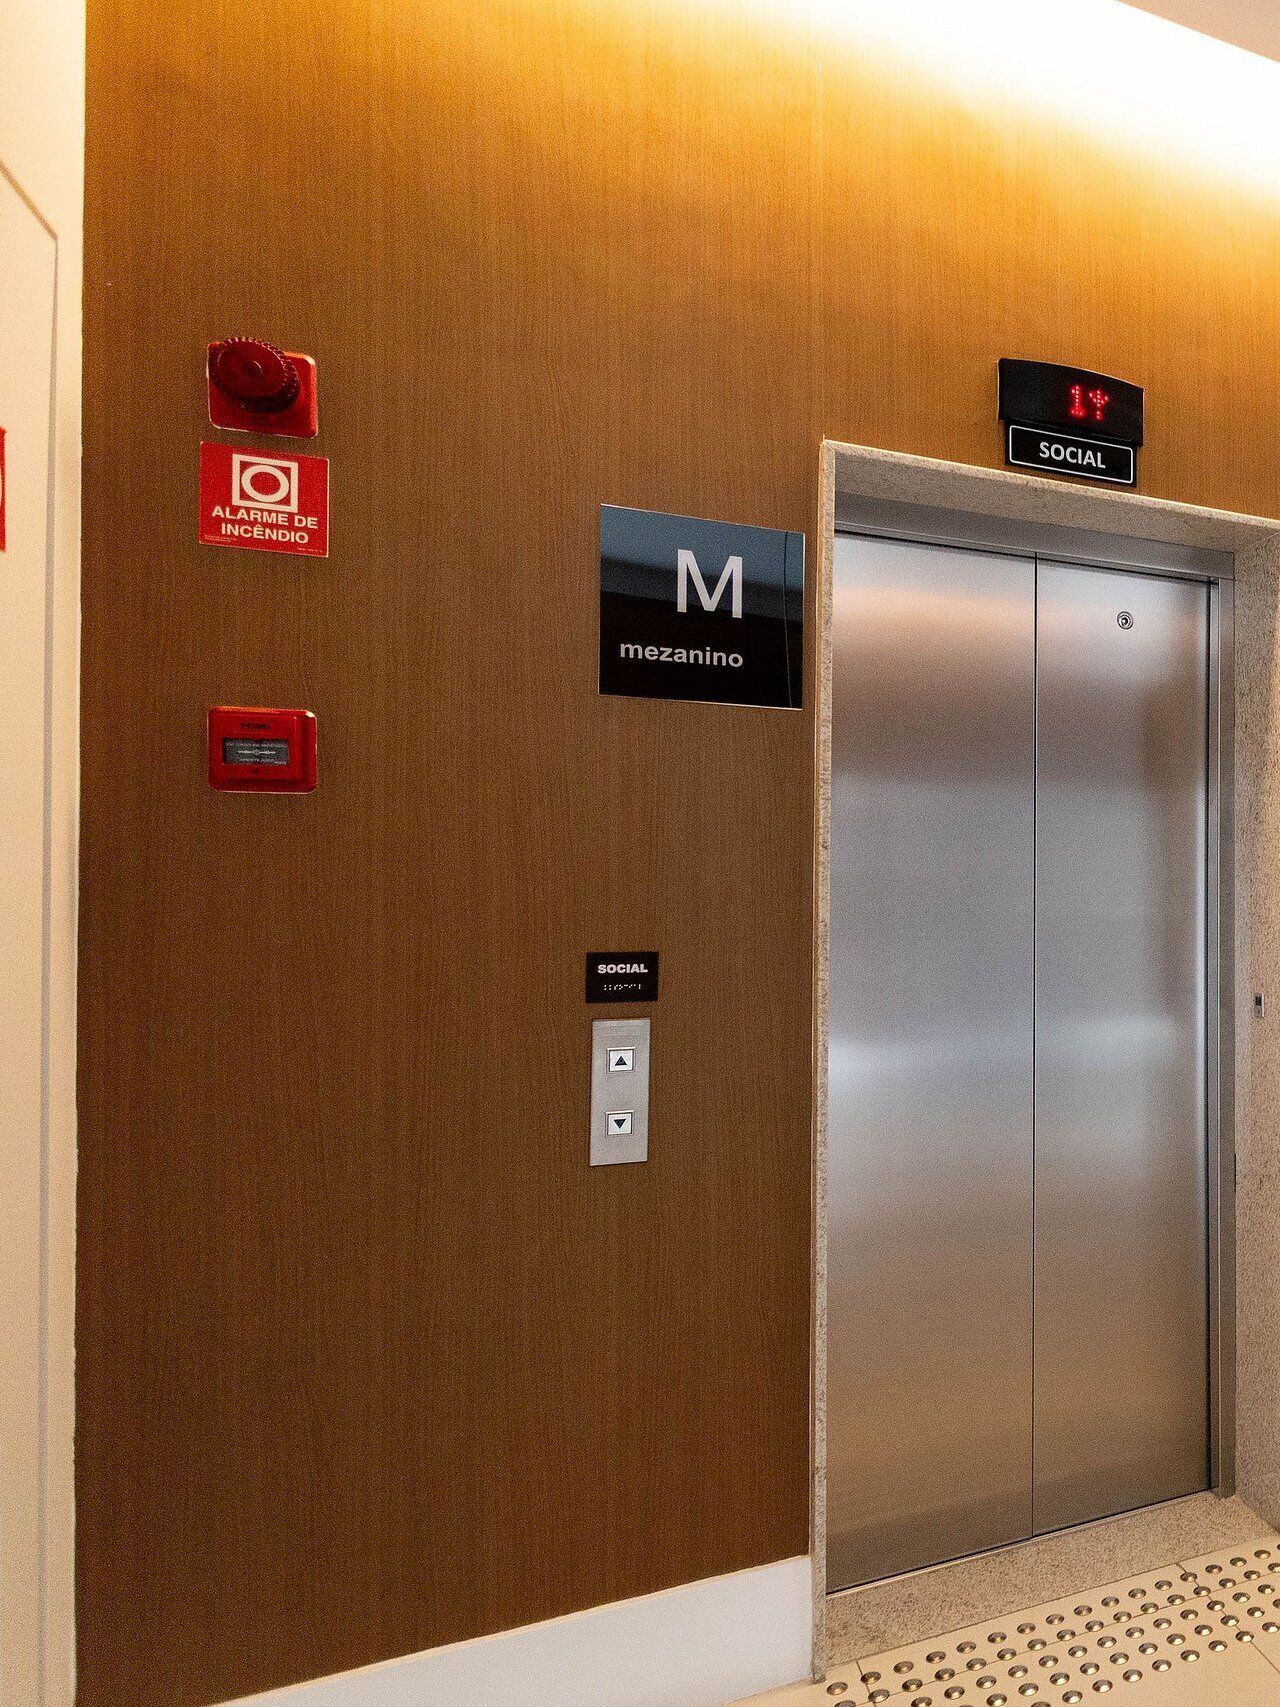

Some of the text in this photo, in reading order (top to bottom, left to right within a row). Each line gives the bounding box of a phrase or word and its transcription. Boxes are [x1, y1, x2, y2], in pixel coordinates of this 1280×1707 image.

[1039, 441, 1106, 469] SOCIAL
[211, 505, 318, 529] ALARME DE
[221, 522, 309, 544] INCÊNDIO
[677, 549, 743, 619] M
[620, 642, 744, 668] mezanino
[597, 963, 648, 974] SOCIAL
